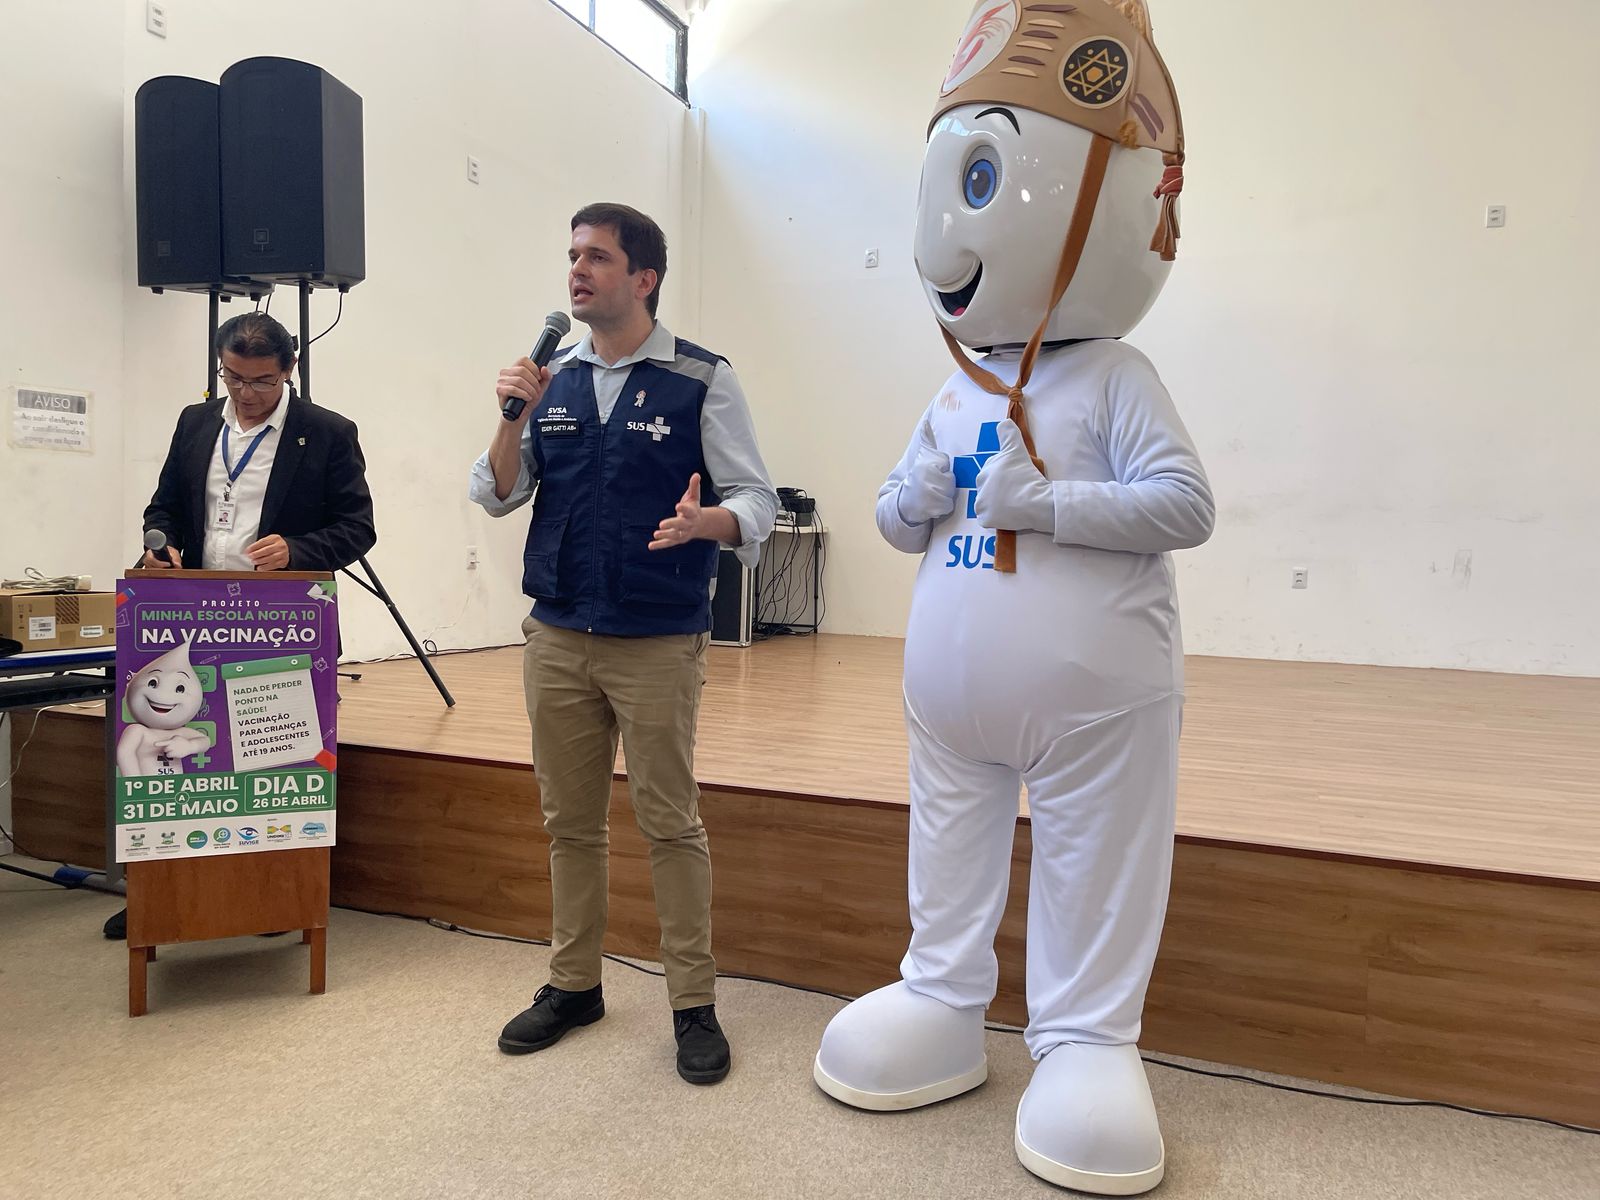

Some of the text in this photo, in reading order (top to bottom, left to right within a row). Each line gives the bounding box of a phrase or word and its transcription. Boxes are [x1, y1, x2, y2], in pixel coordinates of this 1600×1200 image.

[34, 395, 70, 409] AVISO
[626, 422, 645, 431] SUS
[142, 610, 315, 621] MINHA ESCOLA NOTA 10
[142, 624, 316, 647] NA VACINAÇÃO
[233, 686, 258, 695] NADA
[272, 680, 302, 690] PERDER
[235, 696, 264, 706] PONTO
[237, 706, 267, 716] SAÚDE!
[238, 713, 290, 726] VACINAÇÃO
[240, 721, 307, 737] PARA CRIANÇAS
[248, 731, 310, 746] ADOLESCENTES
[243, 748, 258, 757] ATÉ
[270, 744, 295, 753] ANOS.
[149, 780, 175, 794] DE
[181, 776, 239, 792] ABRIL
[254, 774, 324, 795] DIA D
[124, 799, 238, 819] 31 DE MAIO
[253, 794, 327, 809] 26 DE ABRIL
